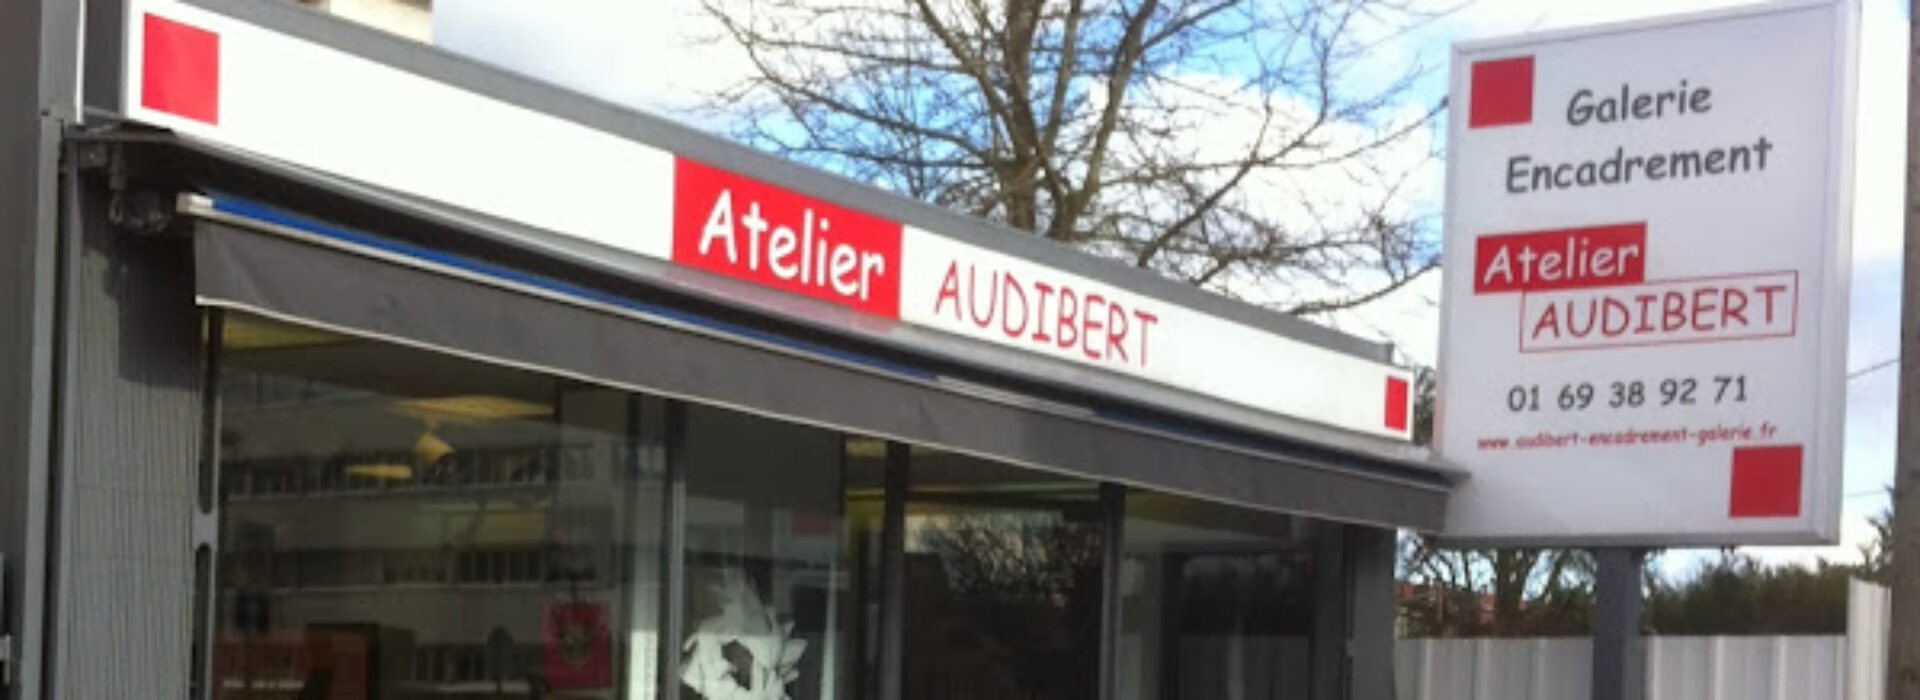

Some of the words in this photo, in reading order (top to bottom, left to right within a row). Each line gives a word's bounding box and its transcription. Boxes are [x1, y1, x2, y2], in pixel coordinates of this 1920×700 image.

[1566, 80, 1712, 126] Galerie
[1506, 137, 1773, 193] Encadrement
[699, 189, 885, 300] Atelier
[935, 260, 1158, 367] AUDIBERT
[1483, 238, 1640, 285] Atelier
[1531, 286, 1787, 340] AUDIBERT
[1507, 386, 1541, 412] 01
[1557, 383, 1595, 411] 69
[1608, 381, 1646, 408] 38
[1659, 378, 1698, 406] 92
[1713, 375, 1748, 403] 71
[1477, 422, 1777, 449] www.audibert-encadrement-galerie.fr
